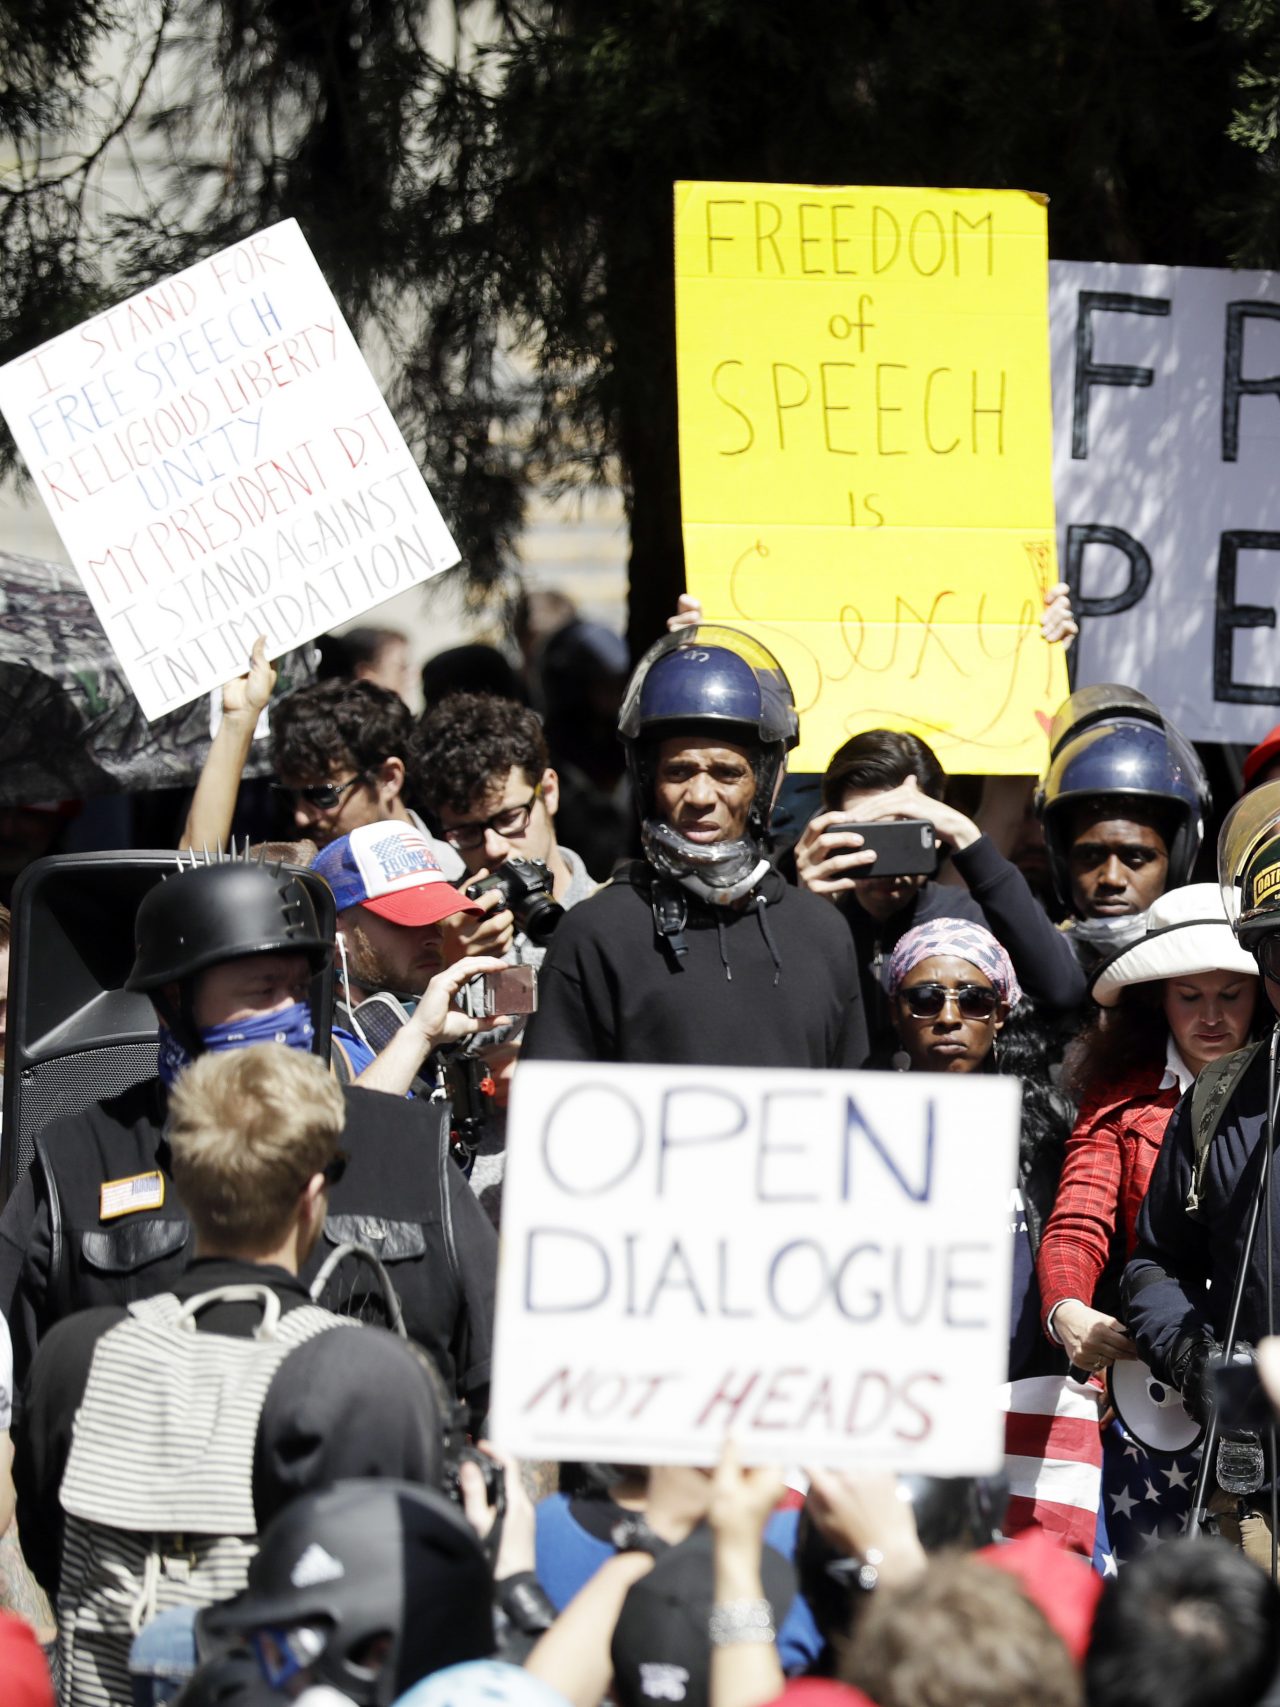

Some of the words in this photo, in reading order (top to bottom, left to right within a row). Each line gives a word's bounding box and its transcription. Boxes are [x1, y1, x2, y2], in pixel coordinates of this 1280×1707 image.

[706, 200, 993, 277] FREEDOM
[19, 345, 67, 398] I
[80, 280, 197, 369] STAND
[210, 236, 286, 295] FOR
[828, 294, 874, 352] of
[28, 370, 137, 455] FREE
[134, 291, 283, 398] SPEECH
[42, 394, 210, 512] RELIGIOUS
[215, 315, 339, 414] LIBERTY
[712, 360, 1005, 456] SPEECH
[137, 407, 264, 511] UNITY
[88, 533, 148, 604] MY
[148, 440, 327, 586] PRESIDENT
[110, 604, 160, 662] I
[156, 548, 271, 641] STAND
[274, 468, 418, 569] AGAINST
[380, 850, 424, 874] TRUMP
[540, 1080, 937, 1204] OPEN
[522, 1225, 993, 1328] DIALOGUE
[522, 1366, 678, 1420] NOT
[696, 1367, 944, 1443] HEADS
